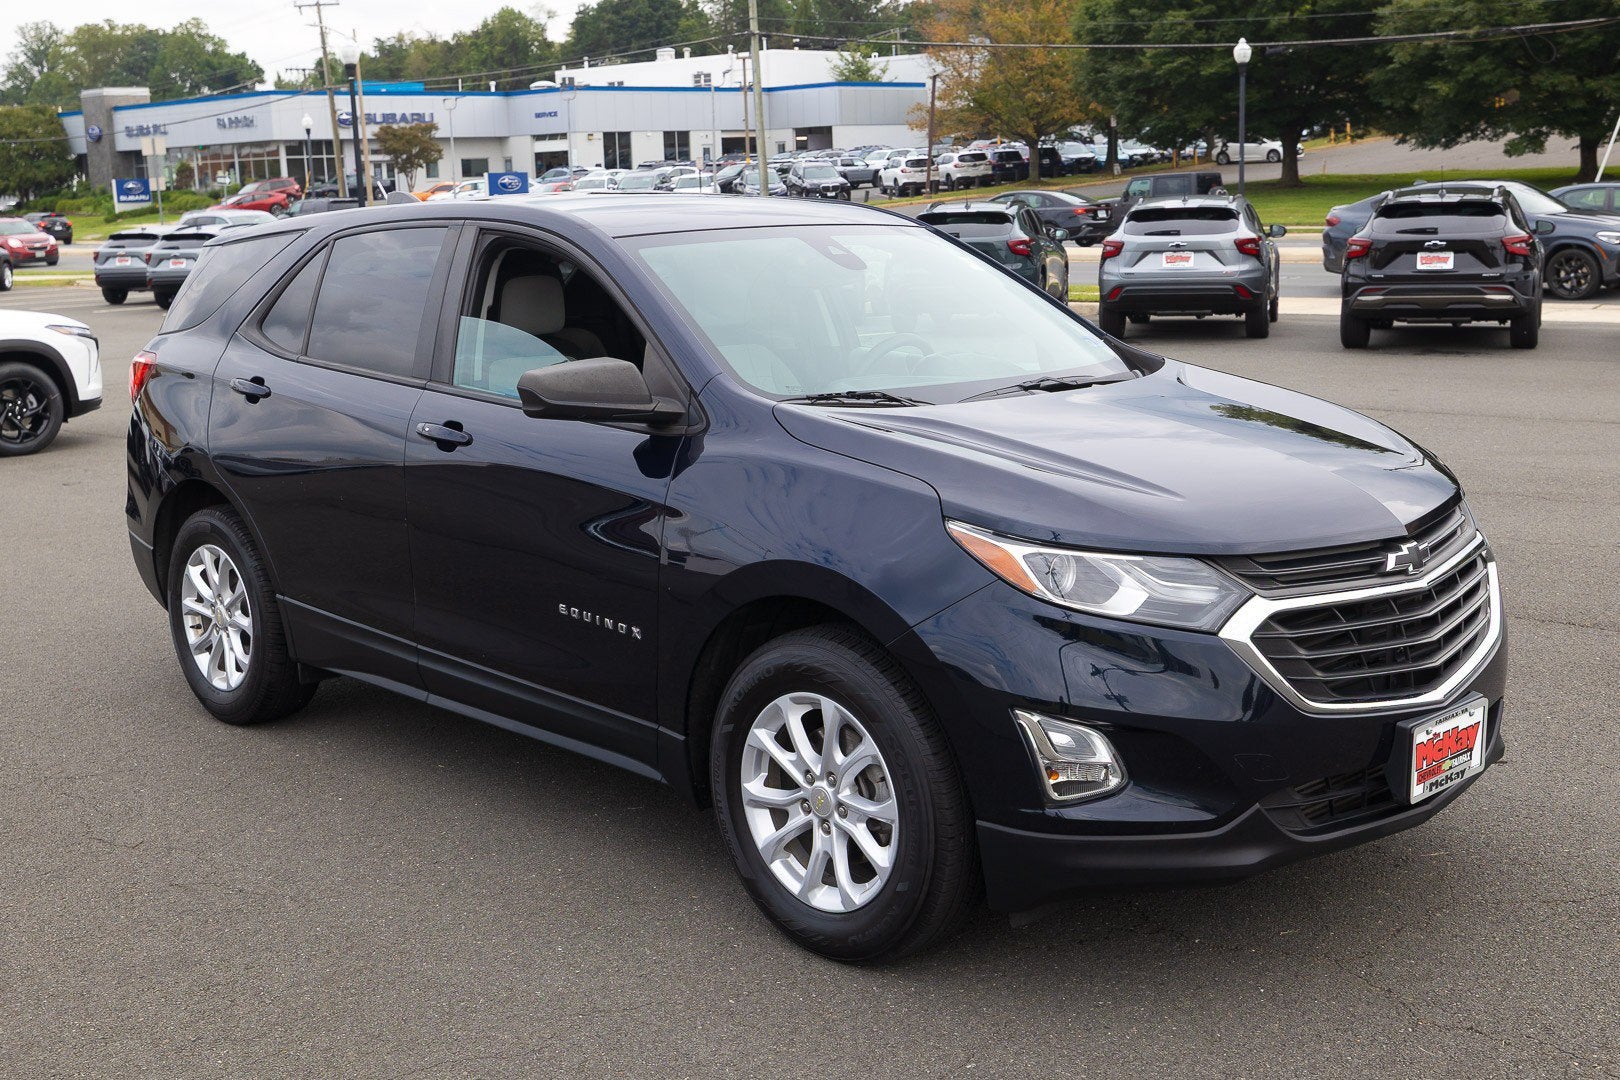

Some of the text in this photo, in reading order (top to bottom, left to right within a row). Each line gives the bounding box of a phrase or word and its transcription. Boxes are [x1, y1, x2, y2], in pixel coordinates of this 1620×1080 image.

[364, 112, 434, 125] SUBARU
[119, 194, 150, 202] SUBARU
[558, 603, 642, 640] EQUINOX
[1415, 720, 1481, 772] McKay
[1428, 768, 1468, 792] McKay
